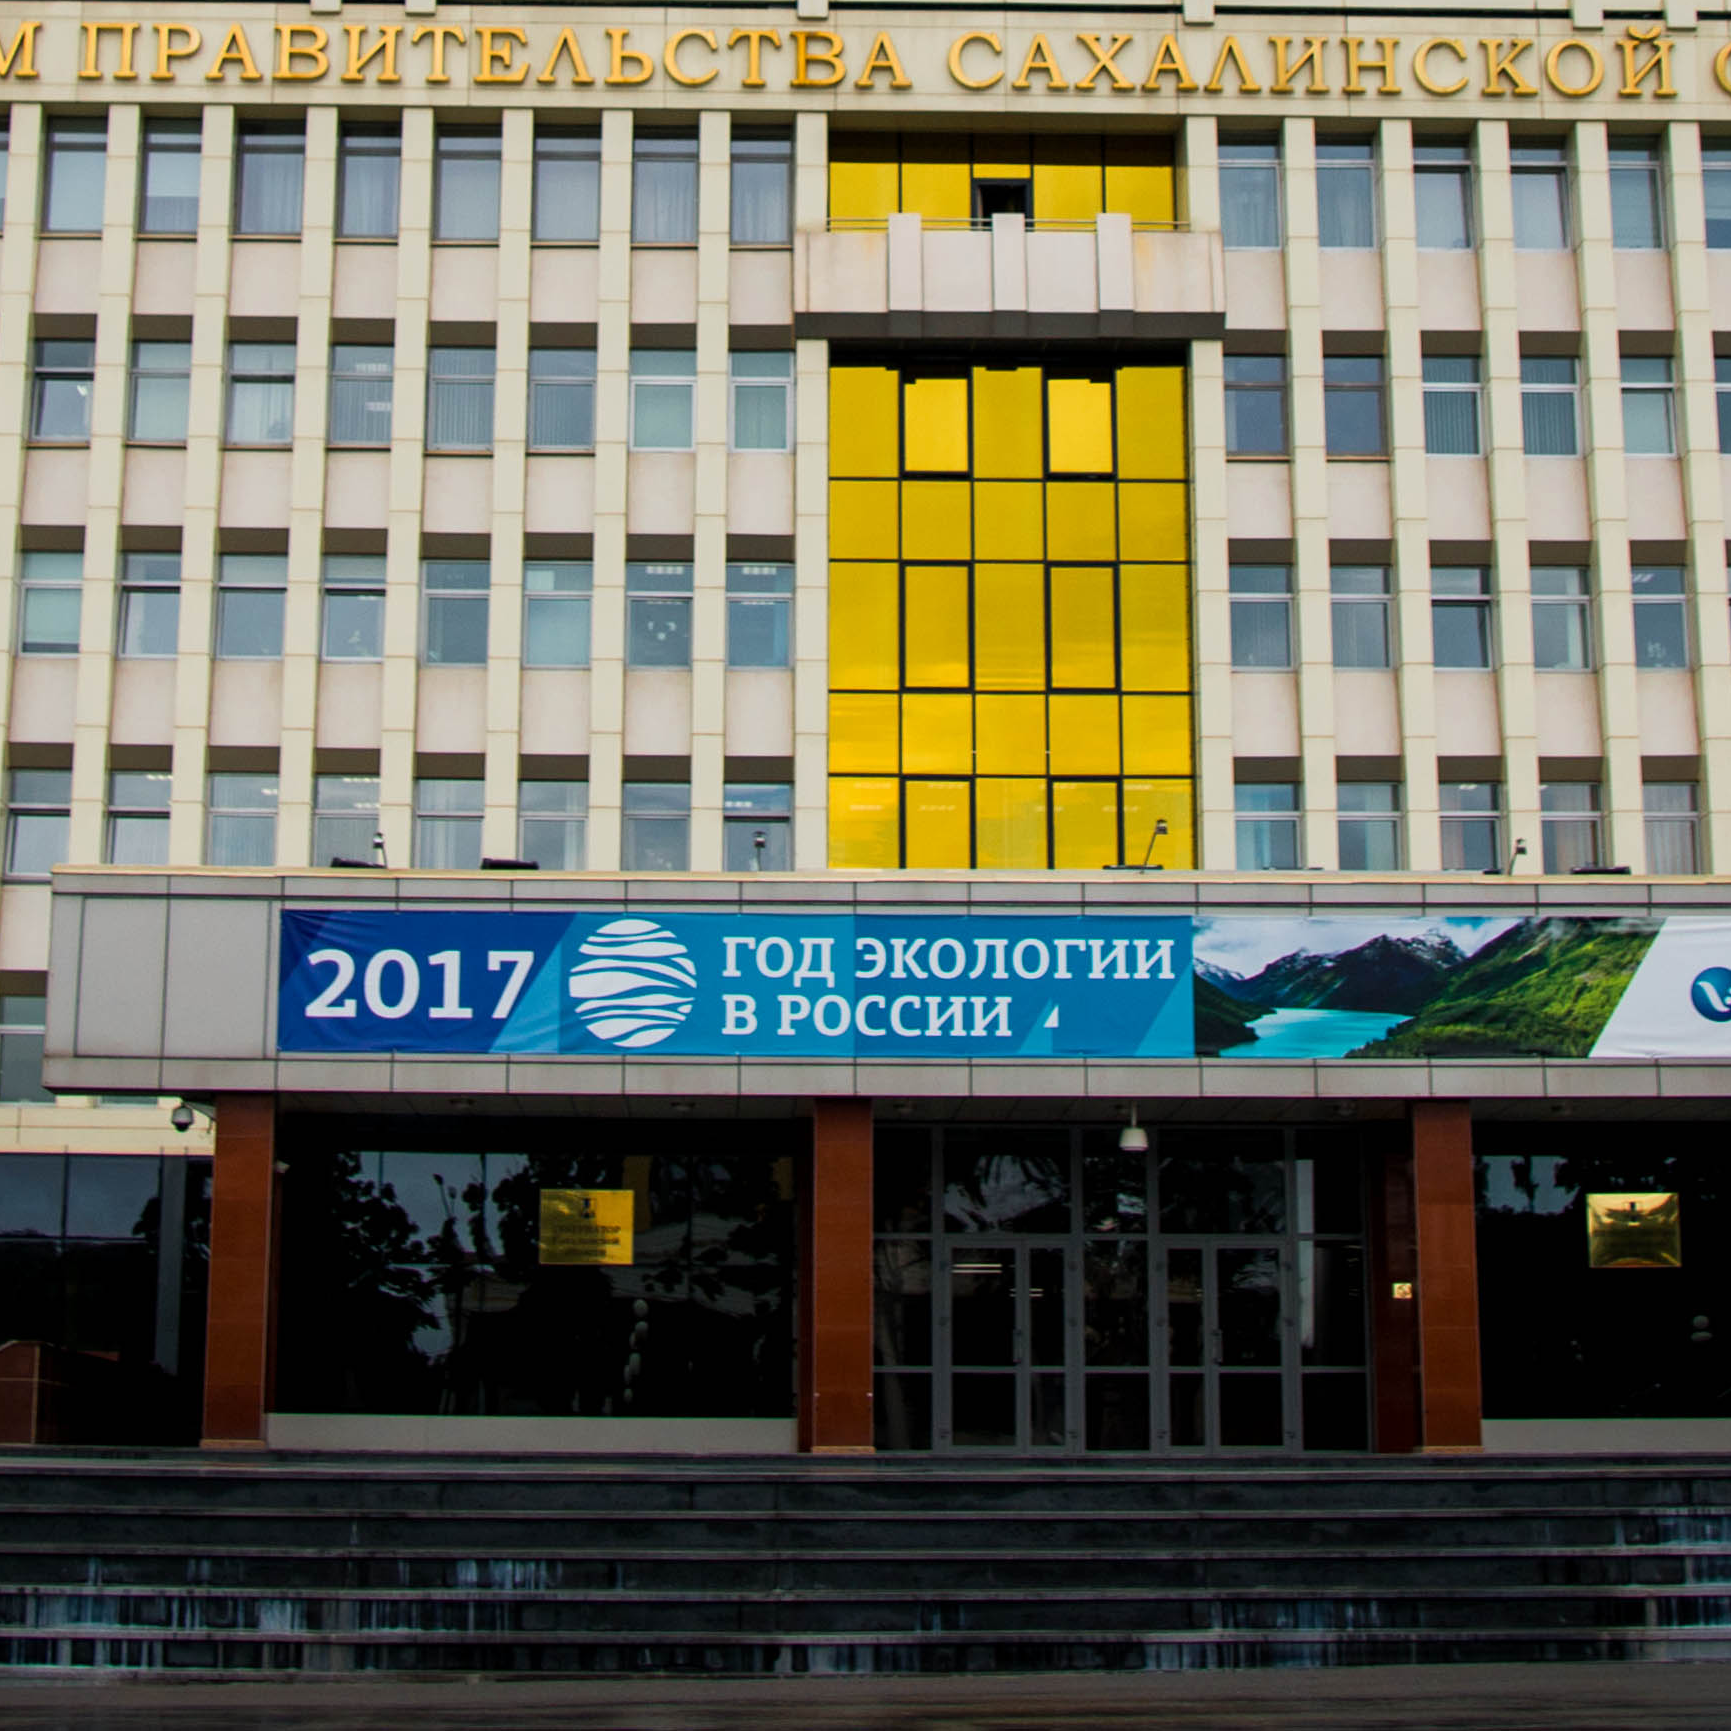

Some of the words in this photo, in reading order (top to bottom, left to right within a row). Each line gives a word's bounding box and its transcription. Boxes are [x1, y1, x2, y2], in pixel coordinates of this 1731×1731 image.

[77, 21, 913, 90] ПРАВИТЕЛЬСТВА
[948, 26, 1678, 96] САХАЛИНСКОЙ
[303, 947, 536, 1021] 2017
[721, 936, 835, 988] ГОД
[855, 937, 1175, 980] ЭКОЛОГИИ
[721, 993, 758, 1036] В
[777, 994, 1013, 1037] РОССИИ
